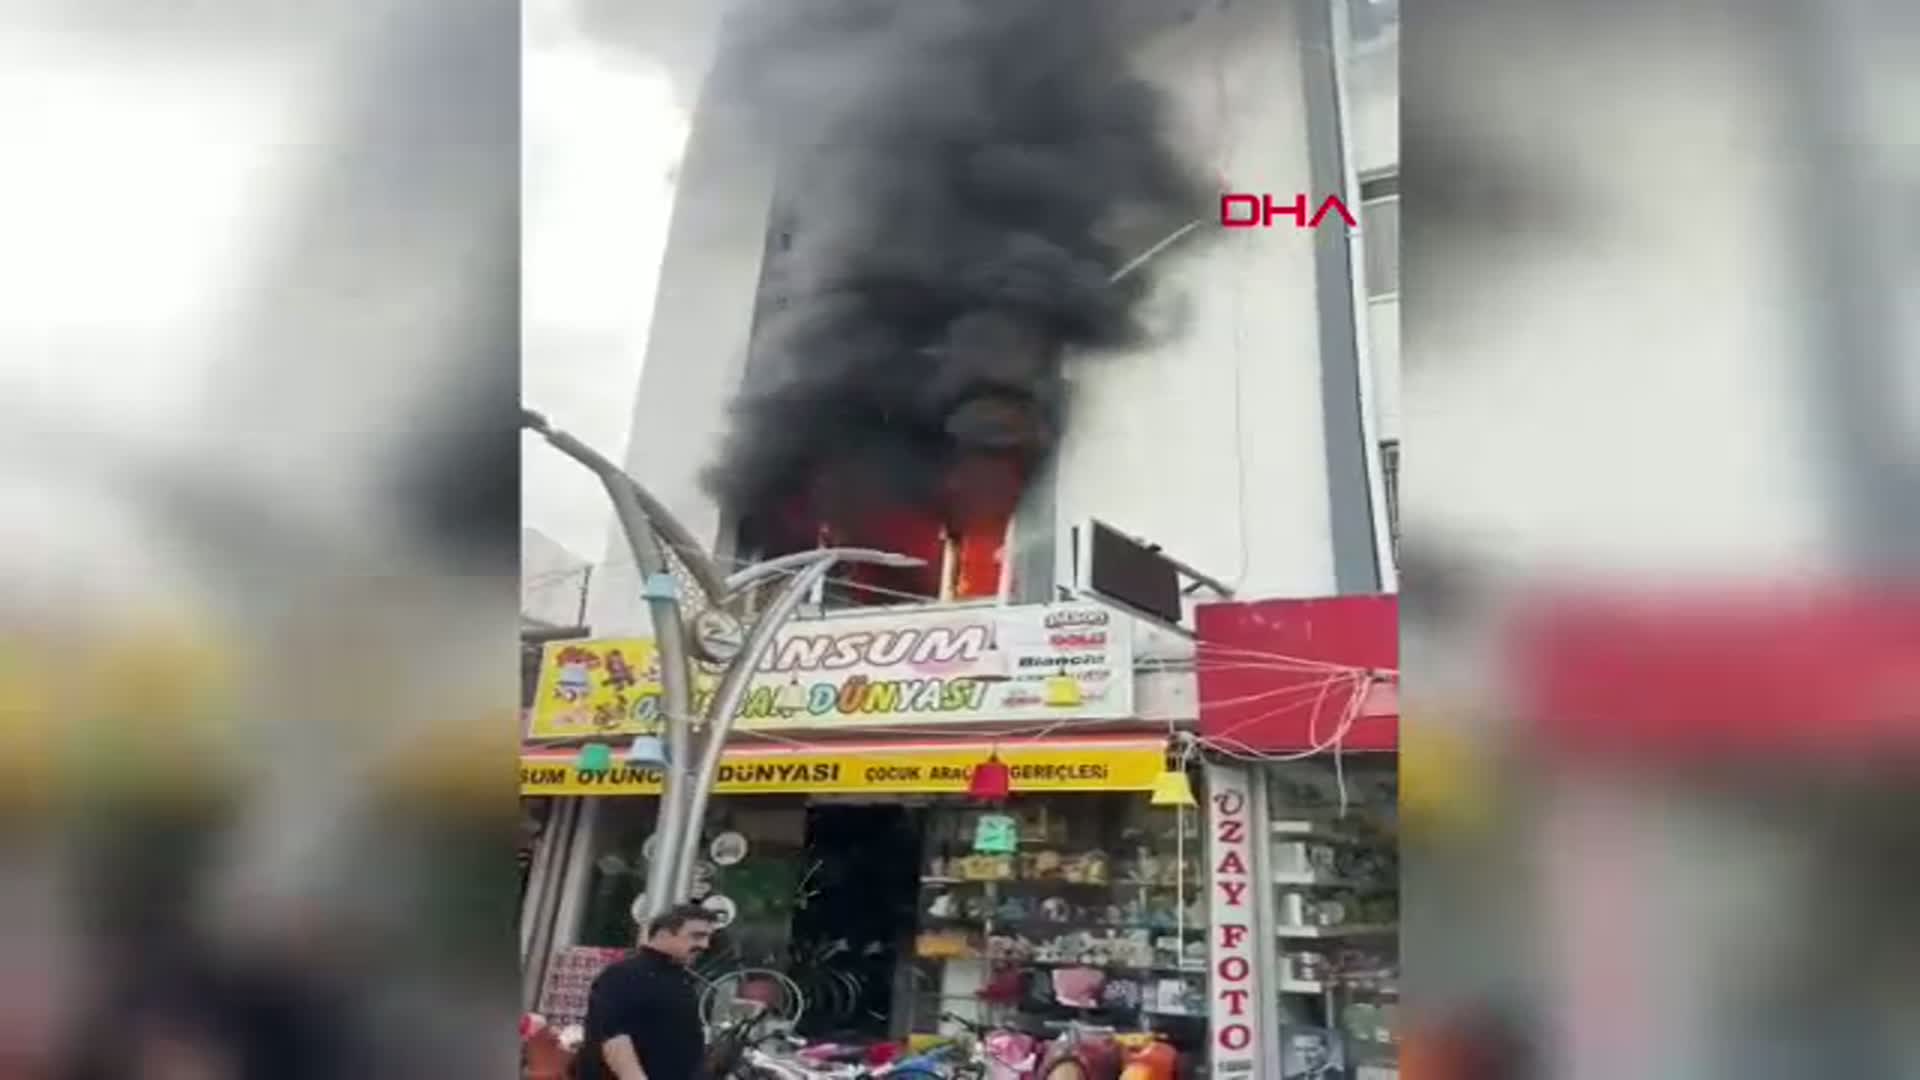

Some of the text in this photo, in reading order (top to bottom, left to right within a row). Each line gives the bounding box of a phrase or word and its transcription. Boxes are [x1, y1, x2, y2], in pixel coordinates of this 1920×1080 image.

[806, 674, 990, 714] DÜNYASI
[576, 765, 663, 785] OYUNC
[716, 762, 840, 784] DÜNYASI
[864, 765, 921, 784] ÇOCUK
[1009, 764, 1110, 783] GEREÇLERİ
[1218, 923, 1252, 1051] FOTO
